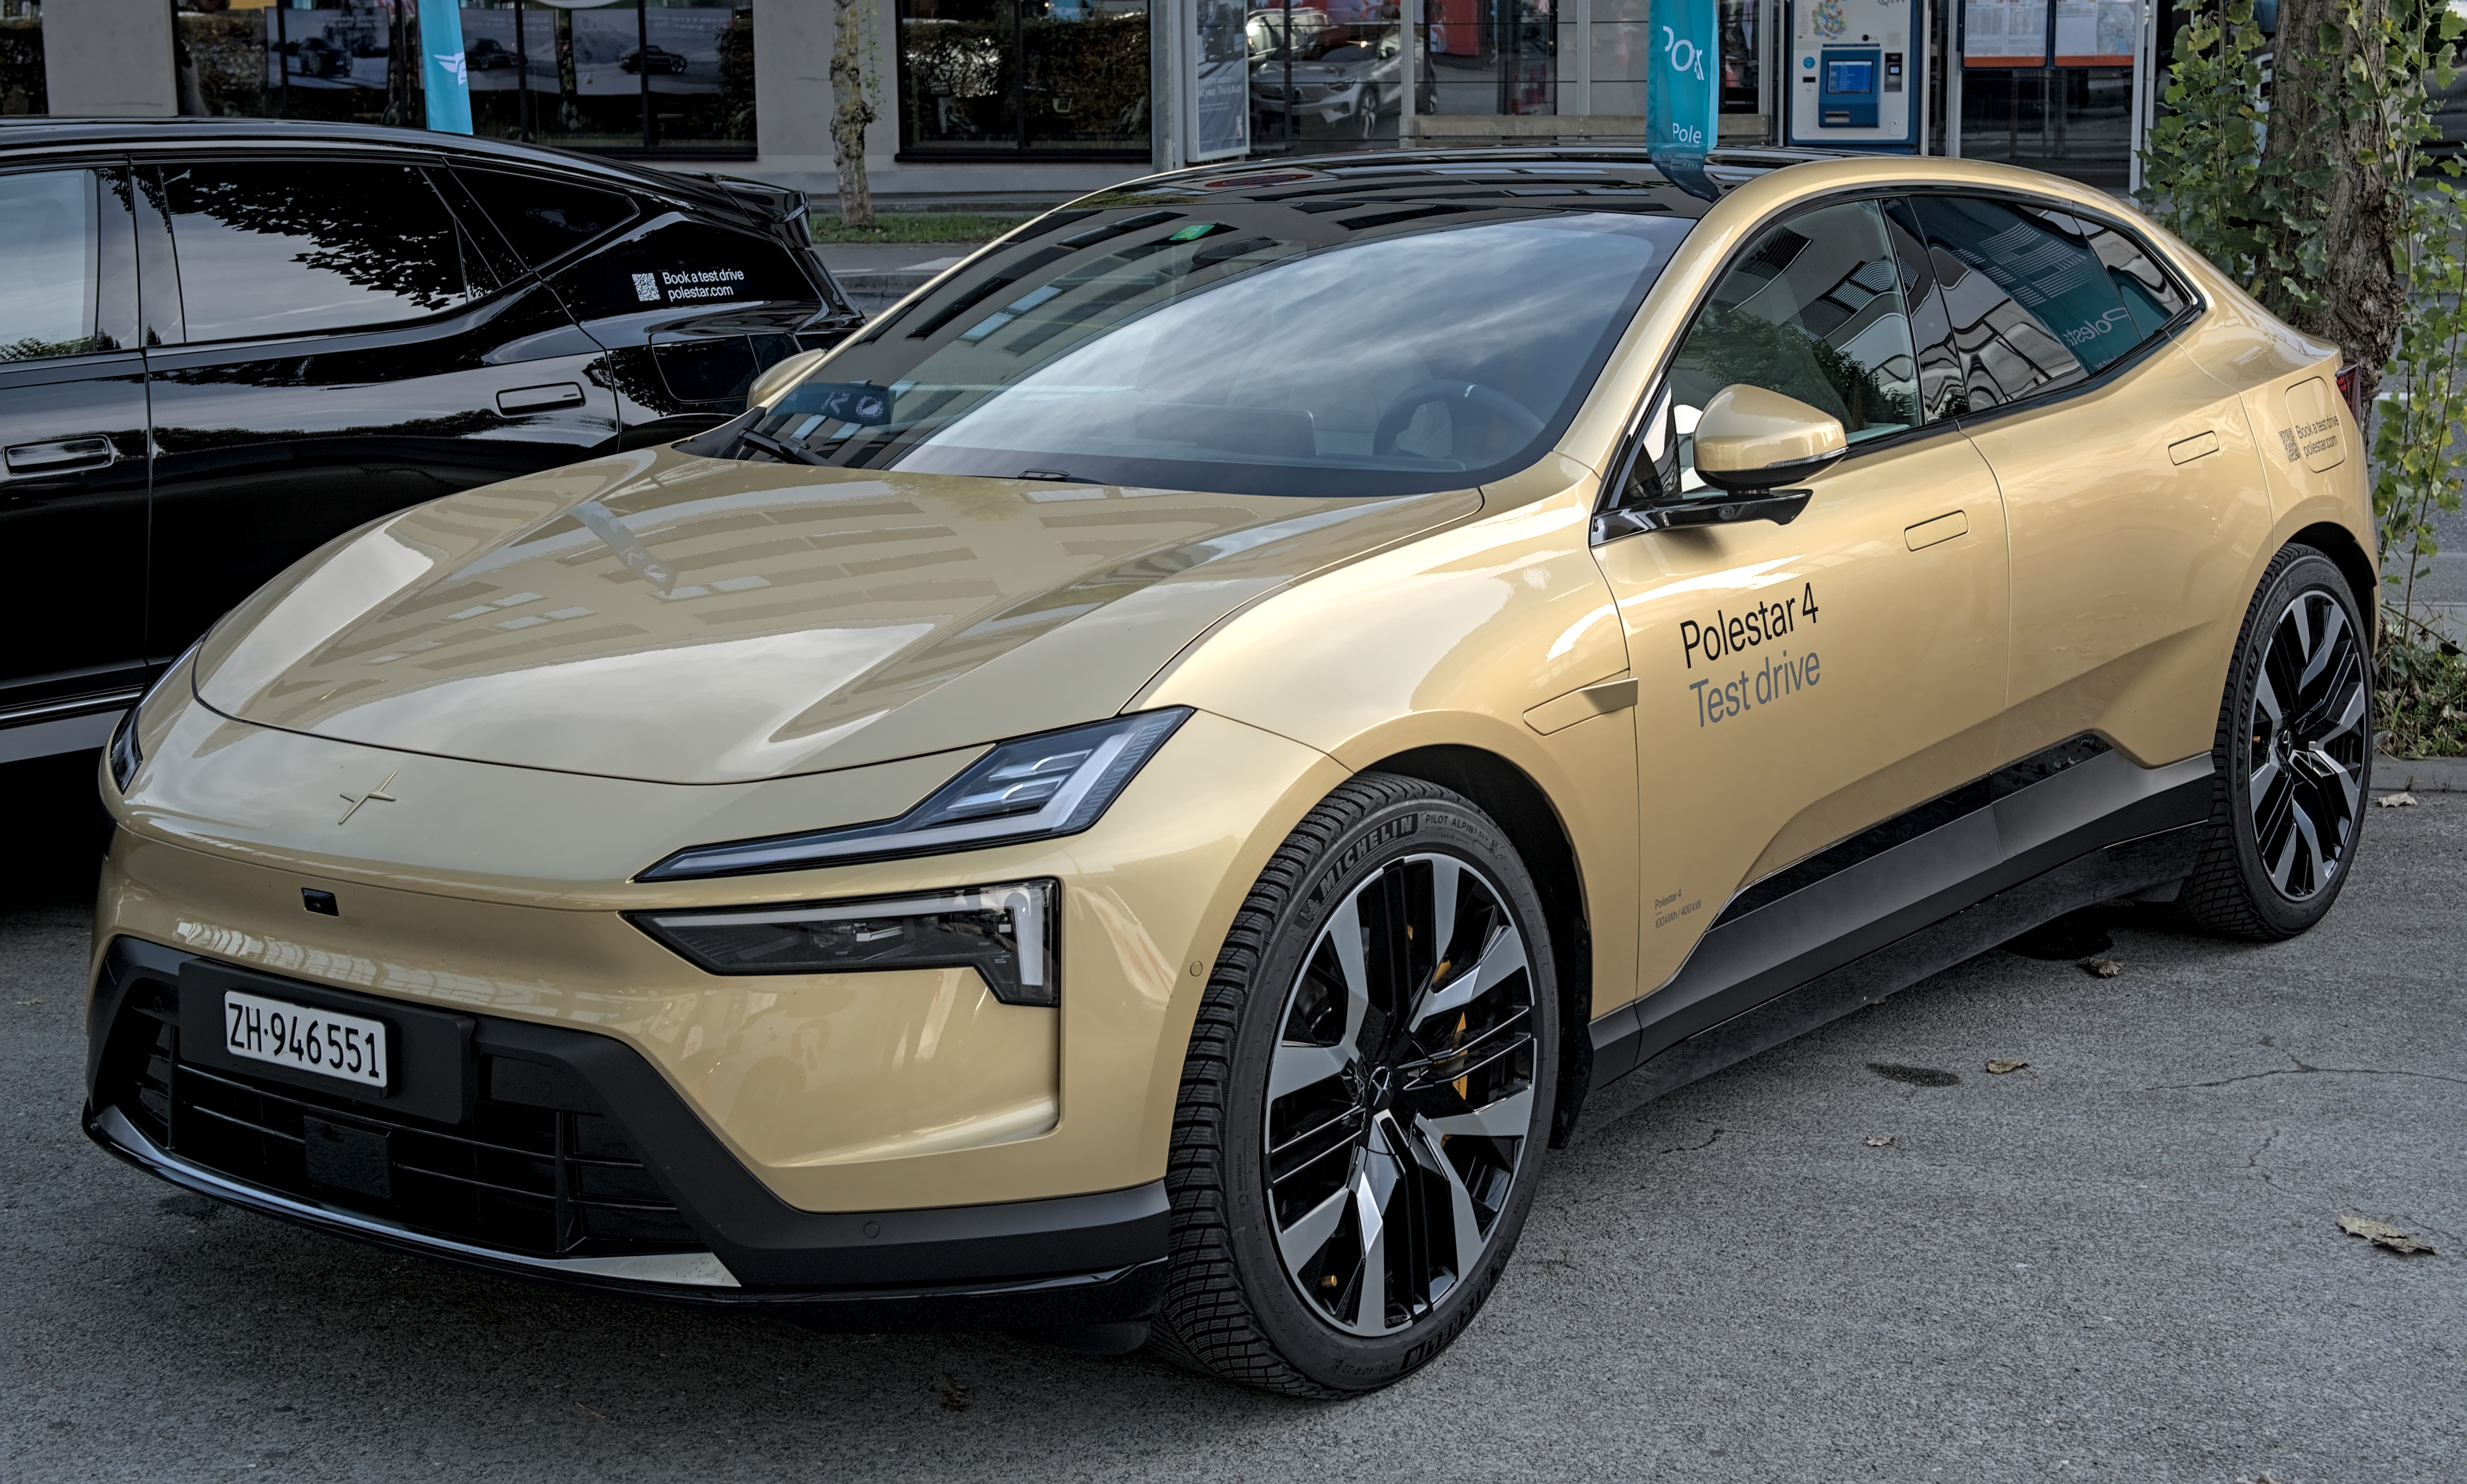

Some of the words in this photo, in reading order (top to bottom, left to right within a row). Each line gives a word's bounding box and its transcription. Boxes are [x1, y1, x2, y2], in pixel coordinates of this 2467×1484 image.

[1672, 123, 1702, 144] Pole
[662, 271, 691, 285] Book
[691, 273, 698, 283] a
[698, 270, 719, 282] test
[719, 268, 744, 281] drive
[667, 286, 734, 302] polestar.com
[2295, 422, 2314, 439] Book
[2312, 423, 2318, 434] a
[2315, 418, 2328, 432] test
[2326, 414, 2339, 429] drive
[2303, 435, 2338, 460] polestar.com
[1680, 597, 1796, 669] Polestar
[1802, 582, 1818, 624] 4
[2258, 617, 2267, 642] PILOT
[1689, 670, 1751, 728] Test
[1755, 650, 1820, 705] drive
[2238, 651, 2258, 759] MICHELIN
[1426, 814, 1449, 825] PILOT
[1479, 831, 1489, 841] SUV
[1320, 816, 1412, 898] MICHELIN
[1655, 893, 1677, 910] Polestar
[1677, 889, 1681, 898] 4
[1406, 1274, 1491, 1368] MICHELIN
